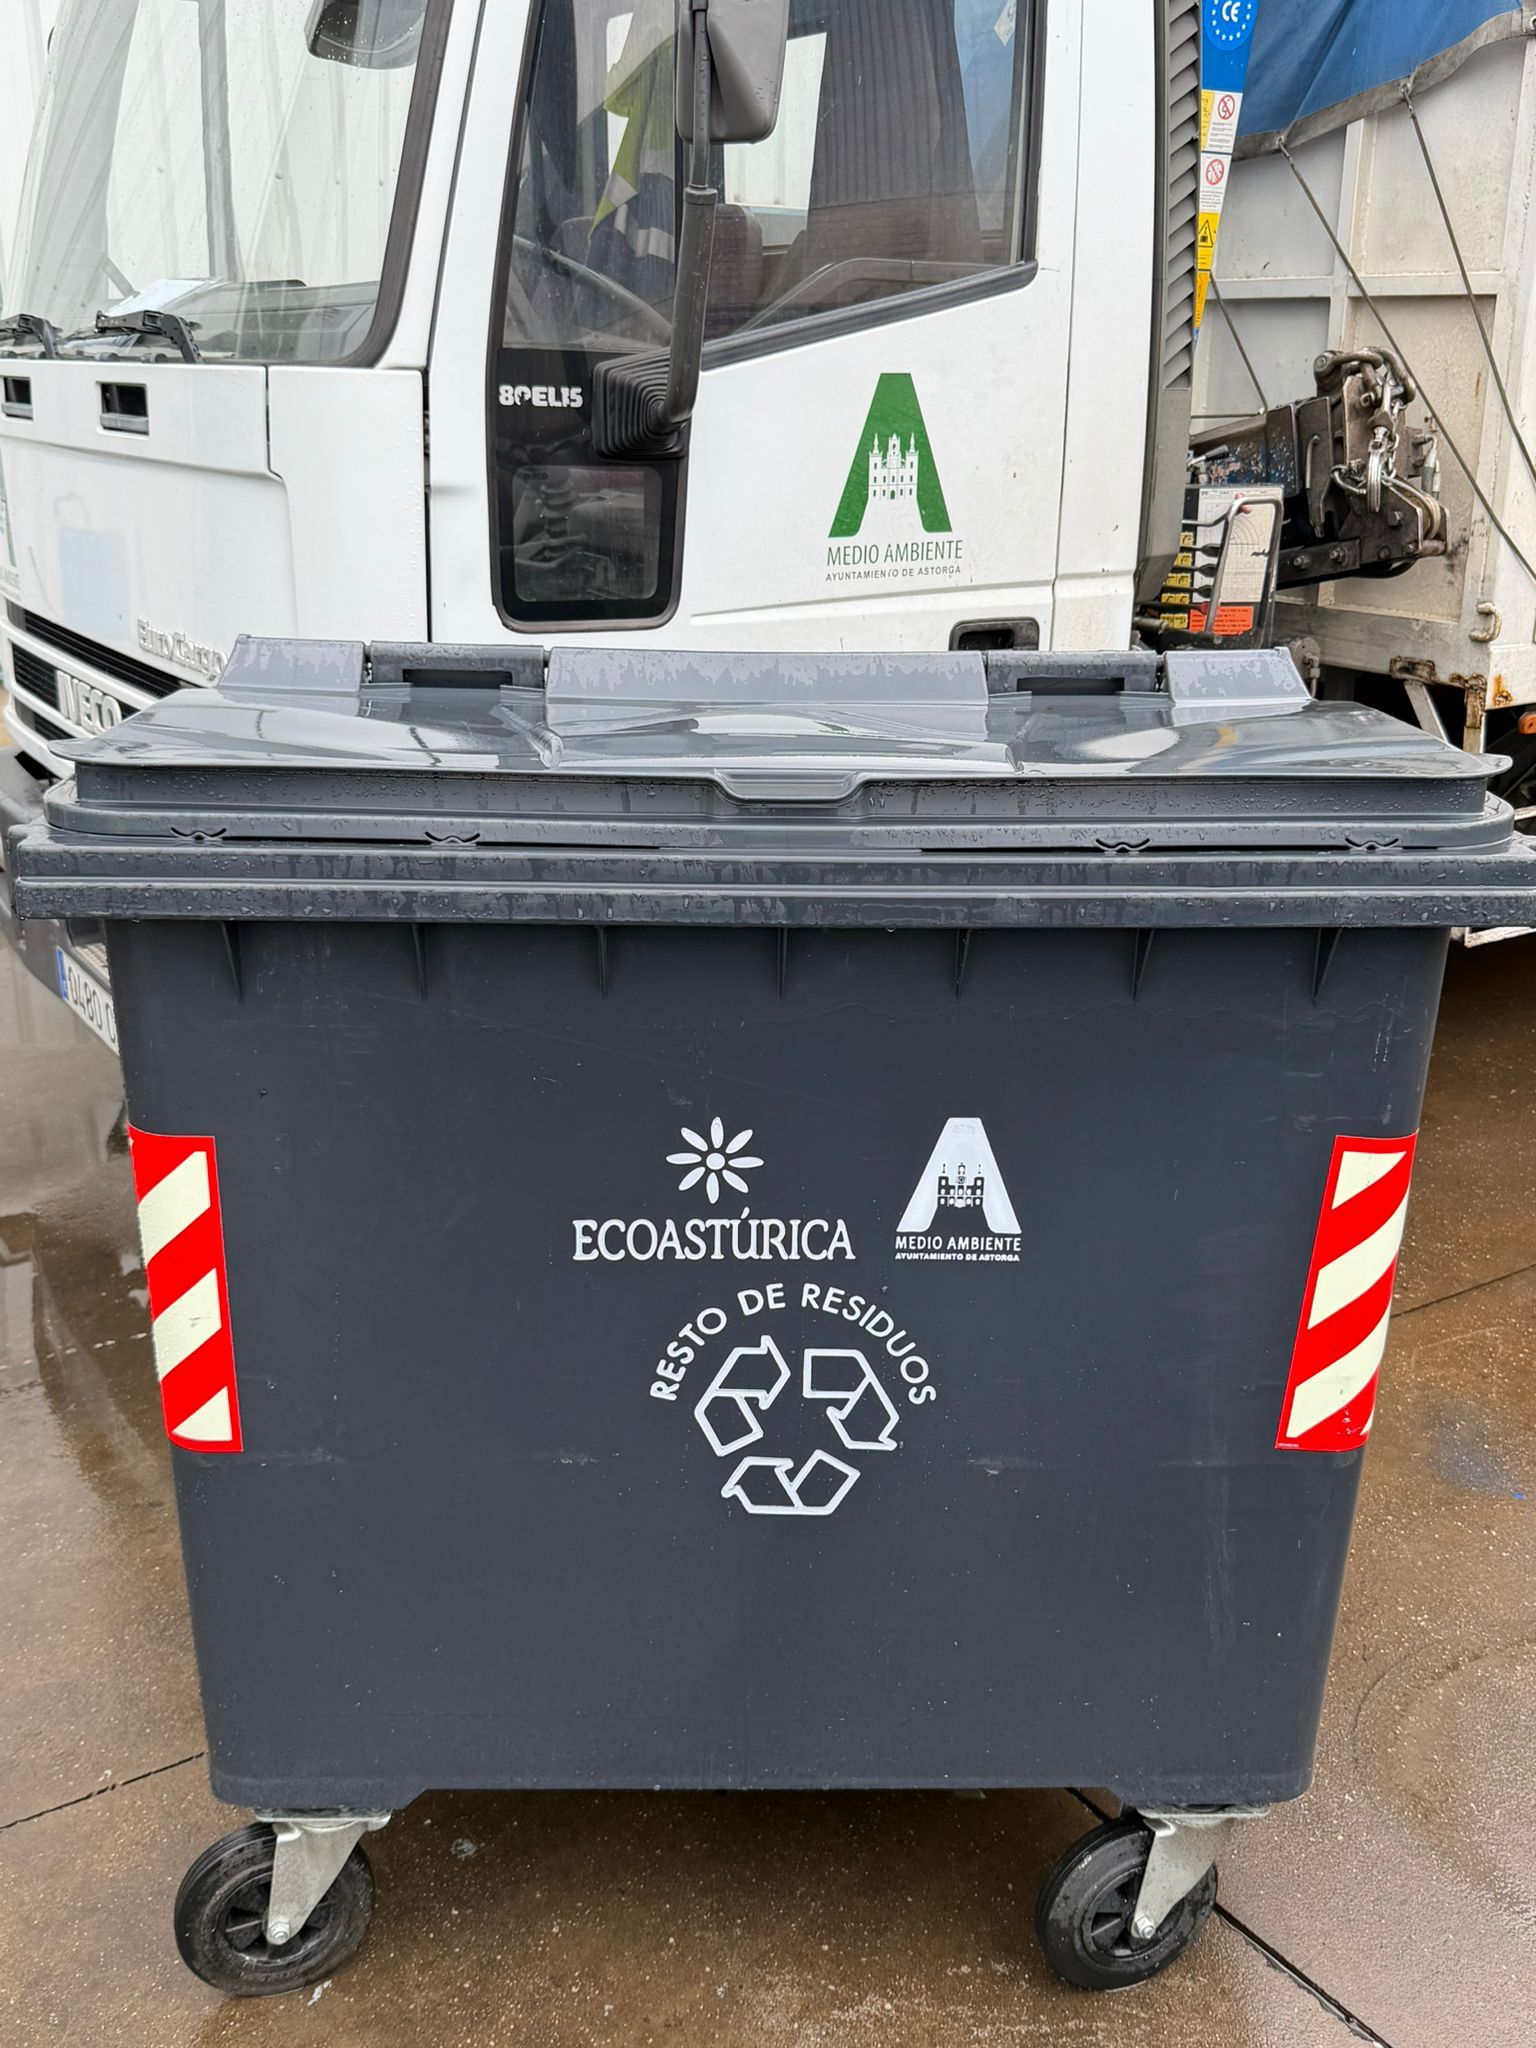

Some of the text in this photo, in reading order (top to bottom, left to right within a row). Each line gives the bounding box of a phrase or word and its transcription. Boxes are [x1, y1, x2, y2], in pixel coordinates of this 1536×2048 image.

[825, 565, 961, 582] AYUNTAMIENTO DE ASTORGA
[826, 539, 963, 567] MEDIO AMBIENTE
[56, 668, 123, 735] IVECO
[67, 965, 103, 1031] 0480
[572, 1206, 856, 1261] ECOASTÚRICA
[895, 1236, 1022, 1251] MEDIO AMBIENTE
[895, 1252, 1020, 1262] AYUNTAMIENTO DE ASTORGA
[650, 1283, 936, 1405] RESTO DE RESIDUOS
